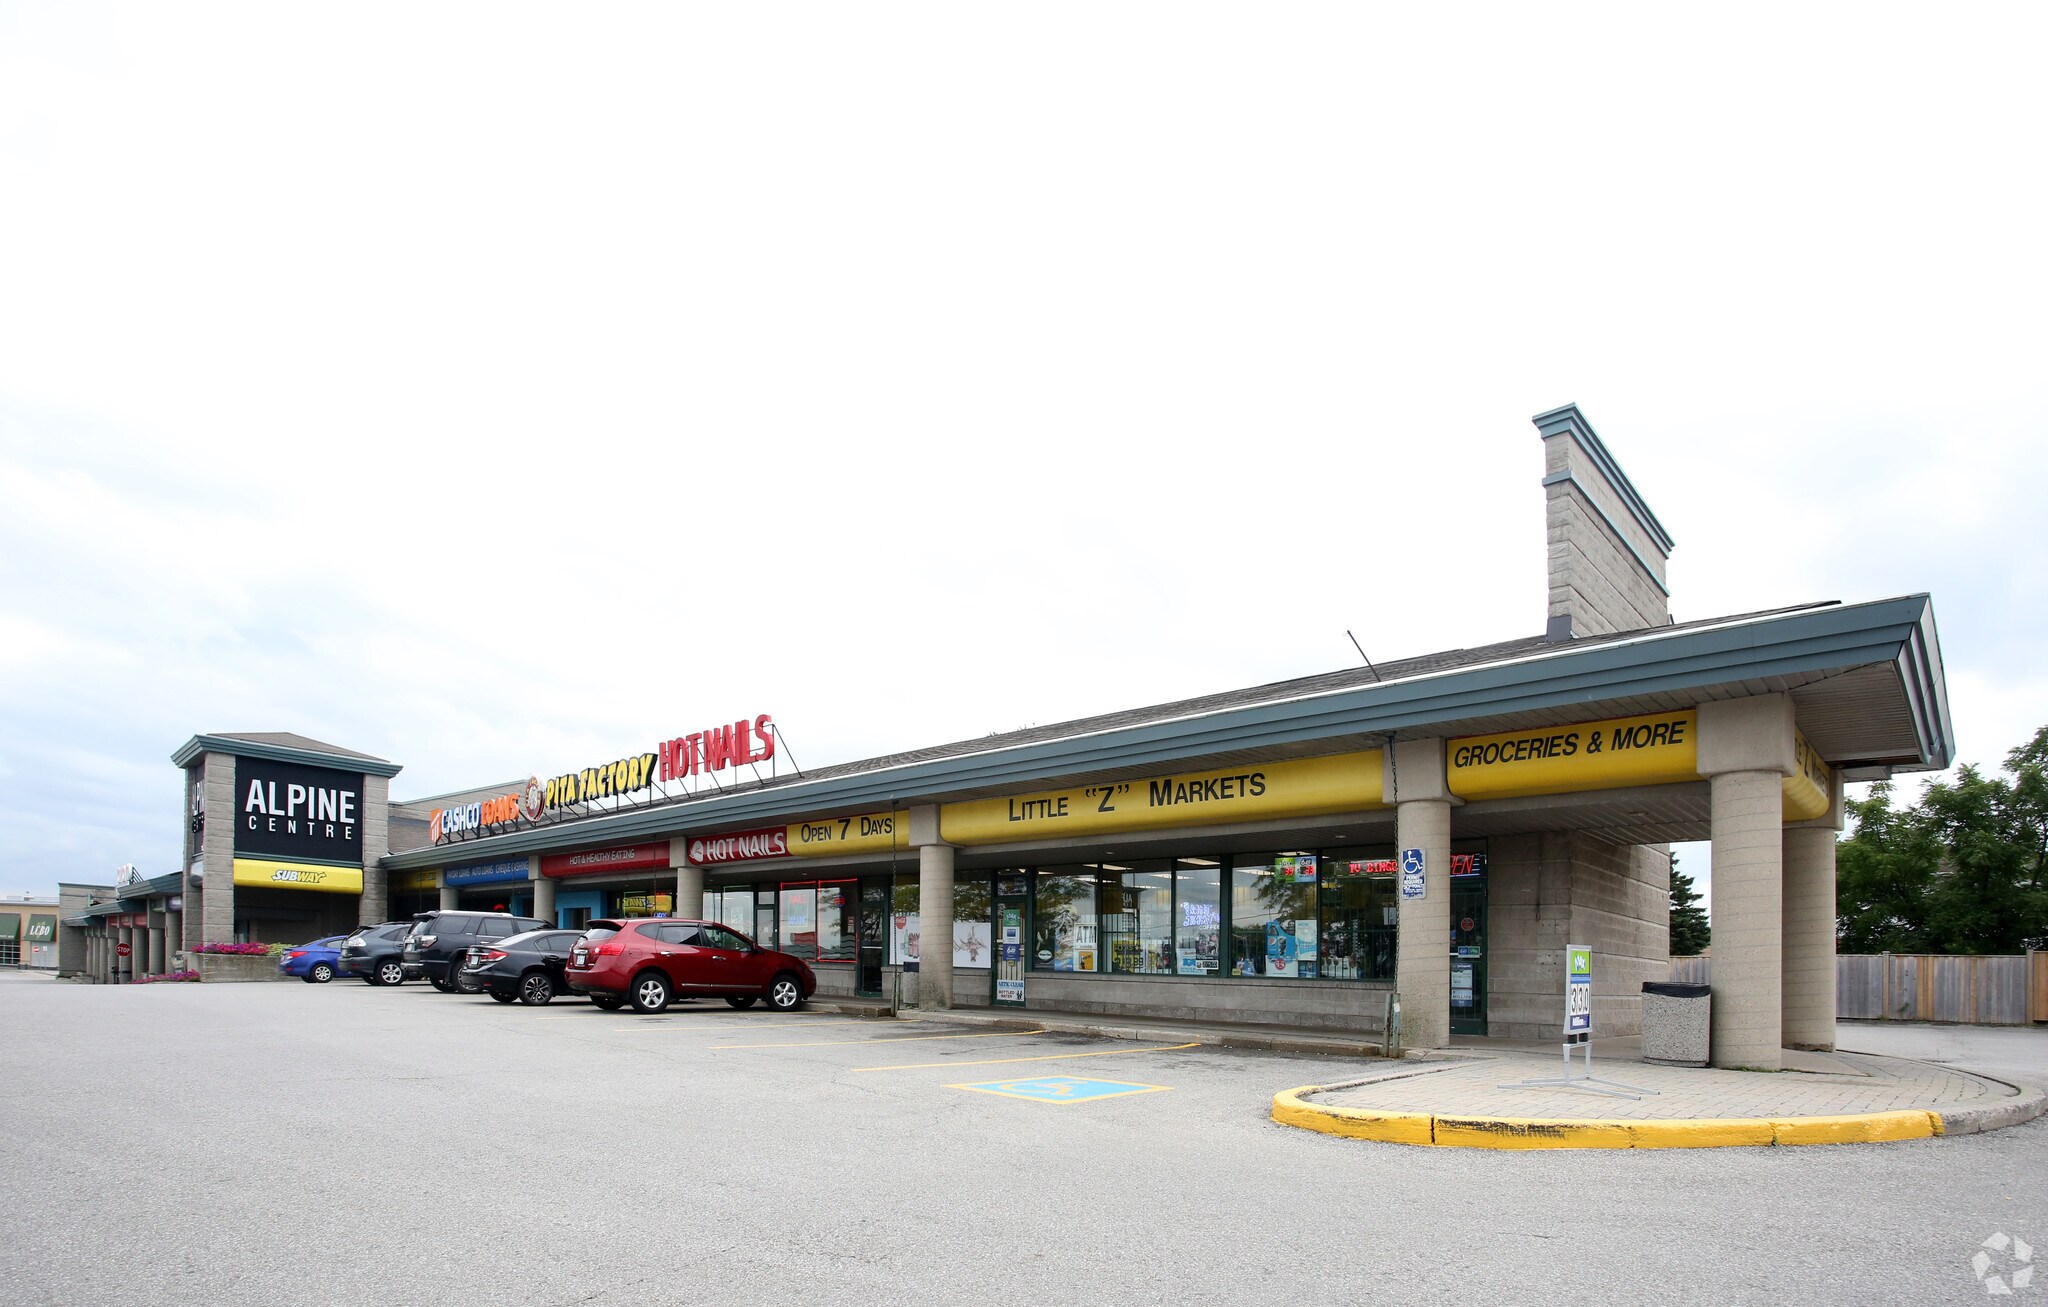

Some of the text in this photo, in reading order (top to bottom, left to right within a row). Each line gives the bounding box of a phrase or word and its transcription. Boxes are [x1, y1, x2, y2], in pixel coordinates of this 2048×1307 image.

[659, 714, 774, 782] HOT NAILS
[1453, 720, 1687, 769] GROCERIES & MORE
[545, 774, 579, 810] PITA
[579, 753, 658, 801] FACTORY
[245, 778, 355, 824] ALPINE
[1008, 797, 1069, 822] LITTLE
[1149, 772, 1267, 807] MARKETS
[441, 792, 520, 834] CASHCO LOANS
[248, 815, 352, 840] CENTRE
[801, 816, 893, 843] OPEN 7 DAYS
[569, 854, 581, 865] HOT
[586, 851, 611, 864] HEALTHY
[611, 849, 636, 860] EATING
[706, 832, 786, 862] HOT NAILS
[271, 869, 327, 884] SUBWAY
[495, 862, 511, 874] CHEQUE
[1366, 860, 1398, 873] BINGO
[1450, 854, 1475, 875] PEN
[30, 925, 50, 936] LCBO
